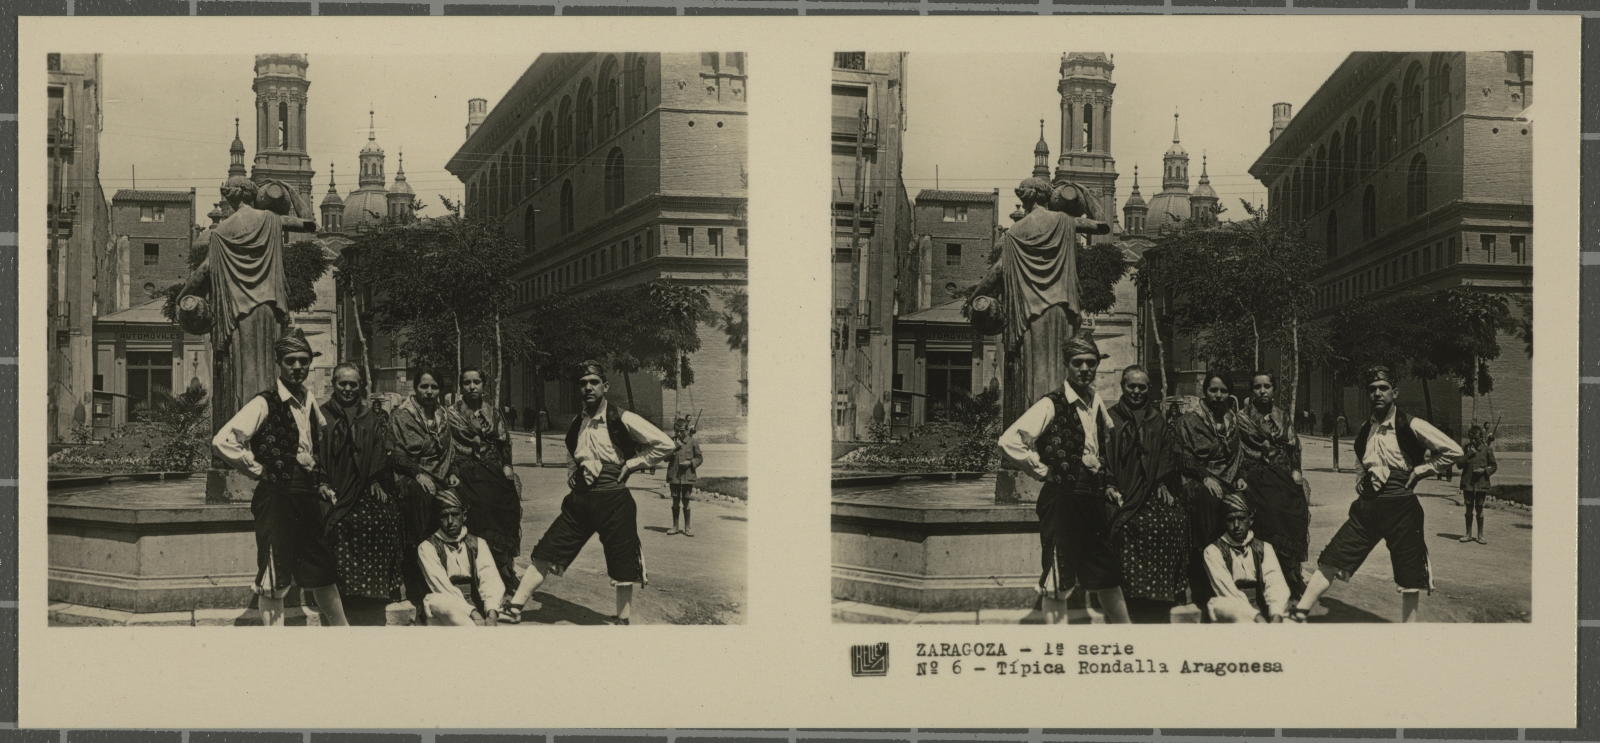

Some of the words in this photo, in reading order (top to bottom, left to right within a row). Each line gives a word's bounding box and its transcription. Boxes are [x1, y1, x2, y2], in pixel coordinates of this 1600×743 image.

[916, 642, 1008, 657] ZARAGOZA
[1078, 642, 1134, 656] serie
[915, 660, 939, 676] Nº
[952, 659, 962, 675] 6
[996, 658, 1066, 677] Típica
[1078, 659, 1169, 674] Rondalla
[1180, 660, 1284, 677] Aragonesa
